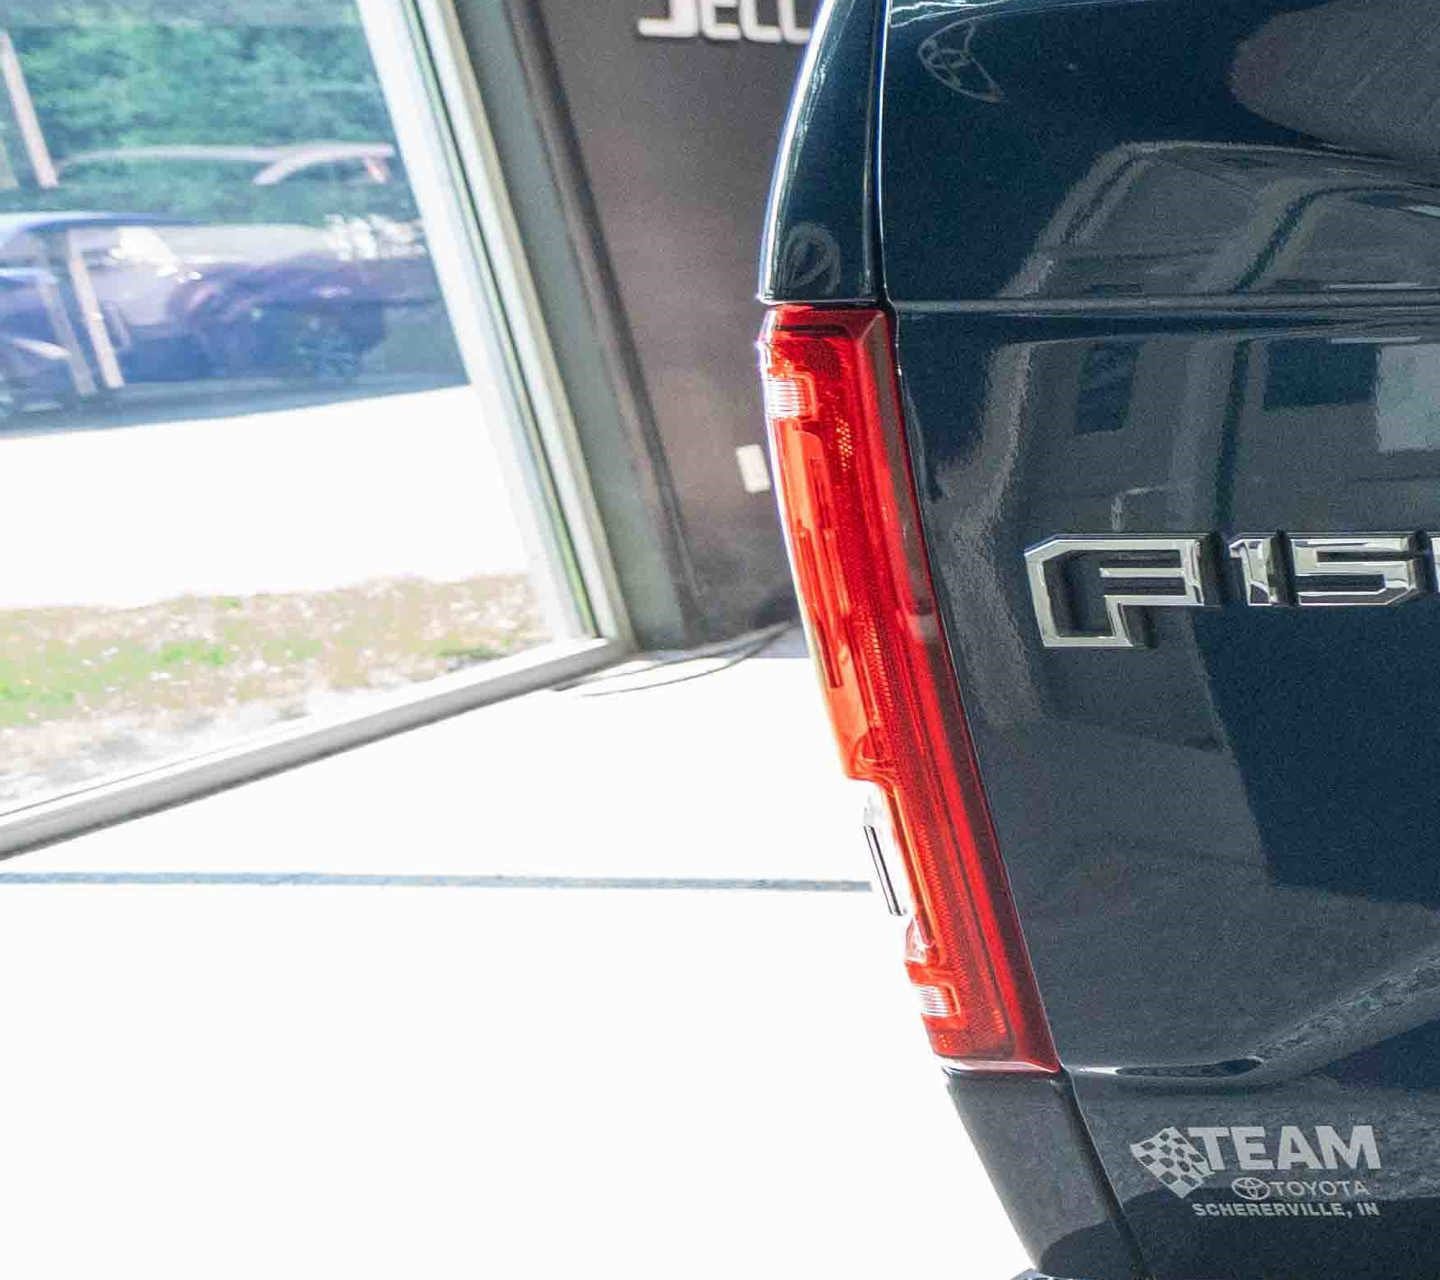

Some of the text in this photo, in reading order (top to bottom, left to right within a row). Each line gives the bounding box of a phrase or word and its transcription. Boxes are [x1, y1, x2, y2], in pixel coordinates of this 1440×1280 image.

[1187, 1124, 1383, 1171] TEAM
[1268, 1179, 1371, 1197] TOYOTA
[1191, 1201, 1380, 1219] SCHERERVILLE, IN
